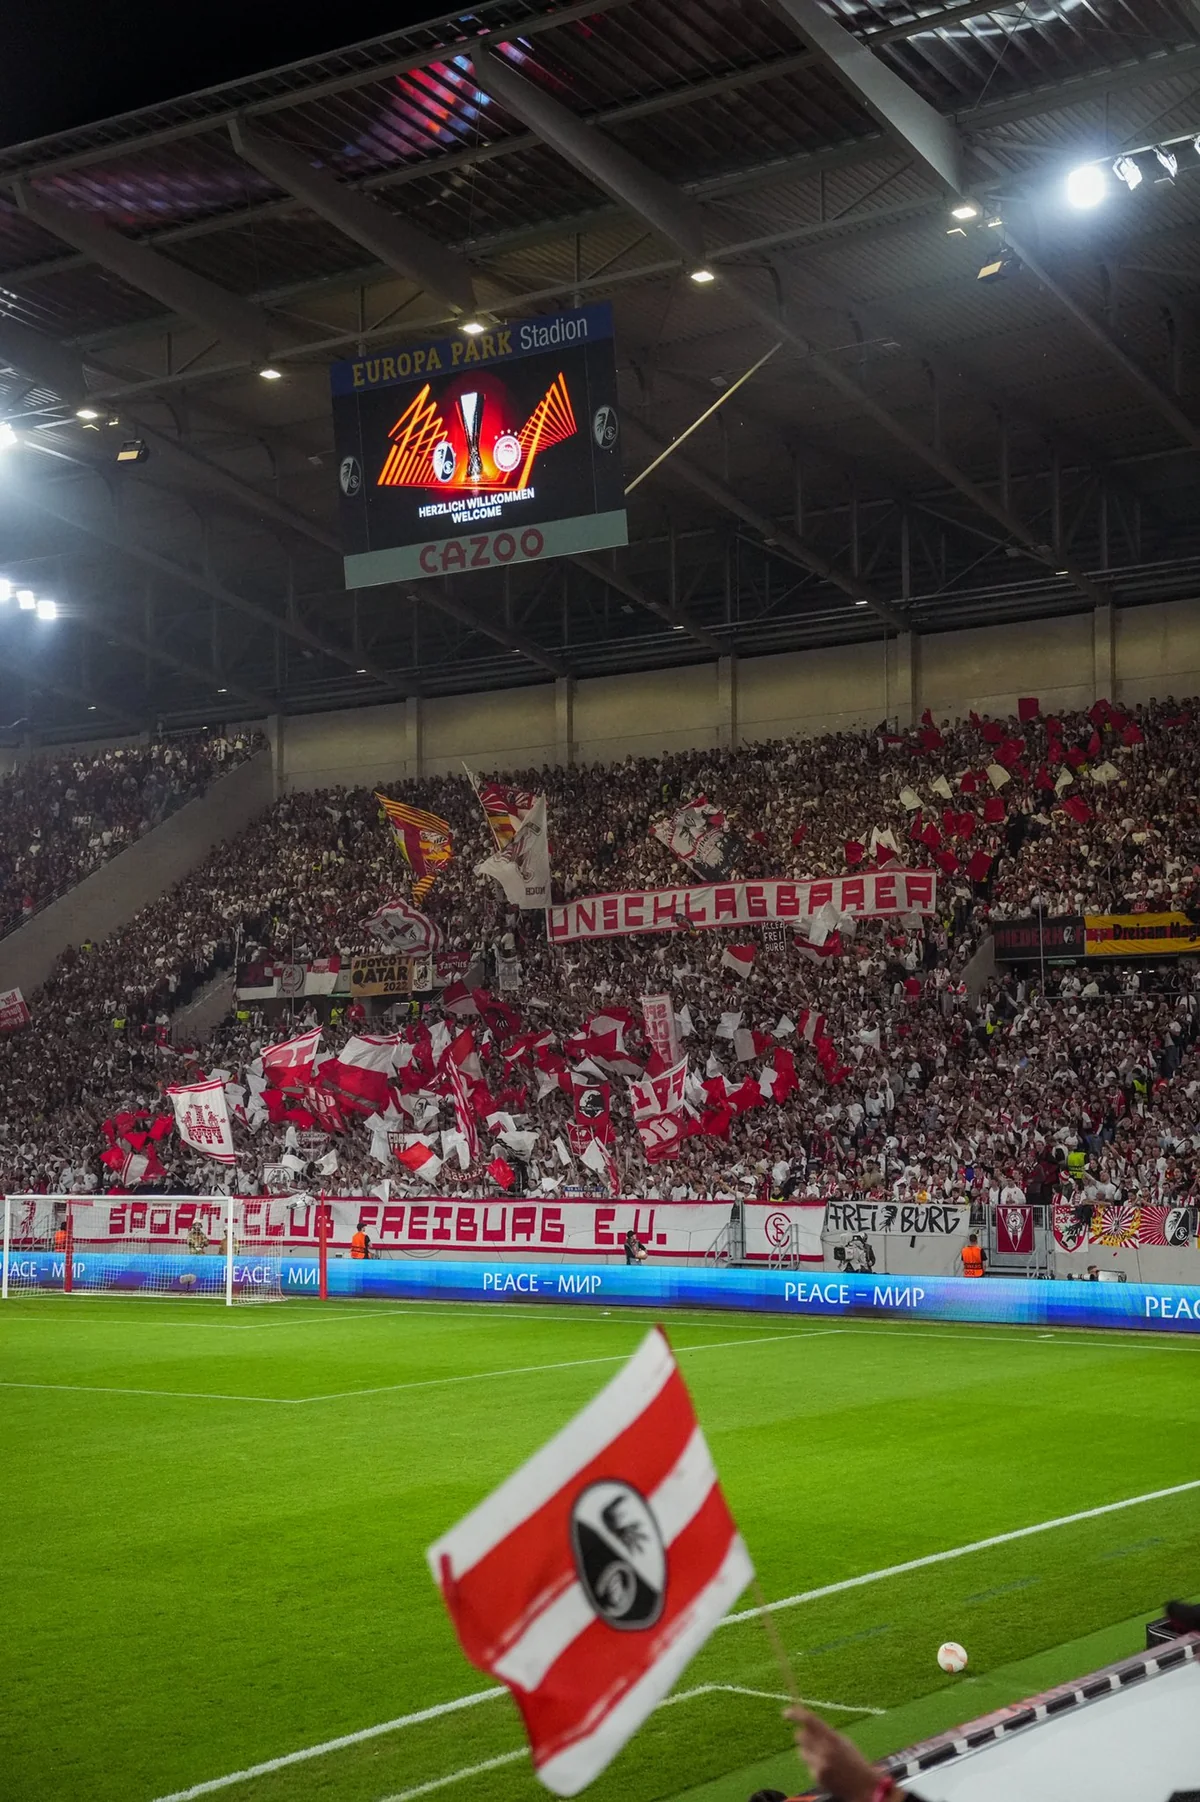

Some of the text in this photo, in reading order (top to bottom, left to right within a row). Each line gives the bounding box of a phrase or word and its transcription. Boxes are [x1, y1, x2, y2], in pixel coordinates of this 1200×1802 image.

[352, 317, 588, 387] EUROPA PARK Stadion
[418, 487, 535, 518] HERZLICH WILLKOMMEN
[451, 506, 502, 523] WELCOME
[419, 528, 544, 574] CAZOO
[354, 956, 410, 969] #BOYCOTT
[352, 967, 408, 988] QATAR
[383, 982, 408, 992] 2022
[901, 1204, 961, 1234] BURG
[0, 1261, 37, 1278] ACE
[483, 1272, 539, 1292] PEACE
[784, 1282, 850, 1304] PEACE
